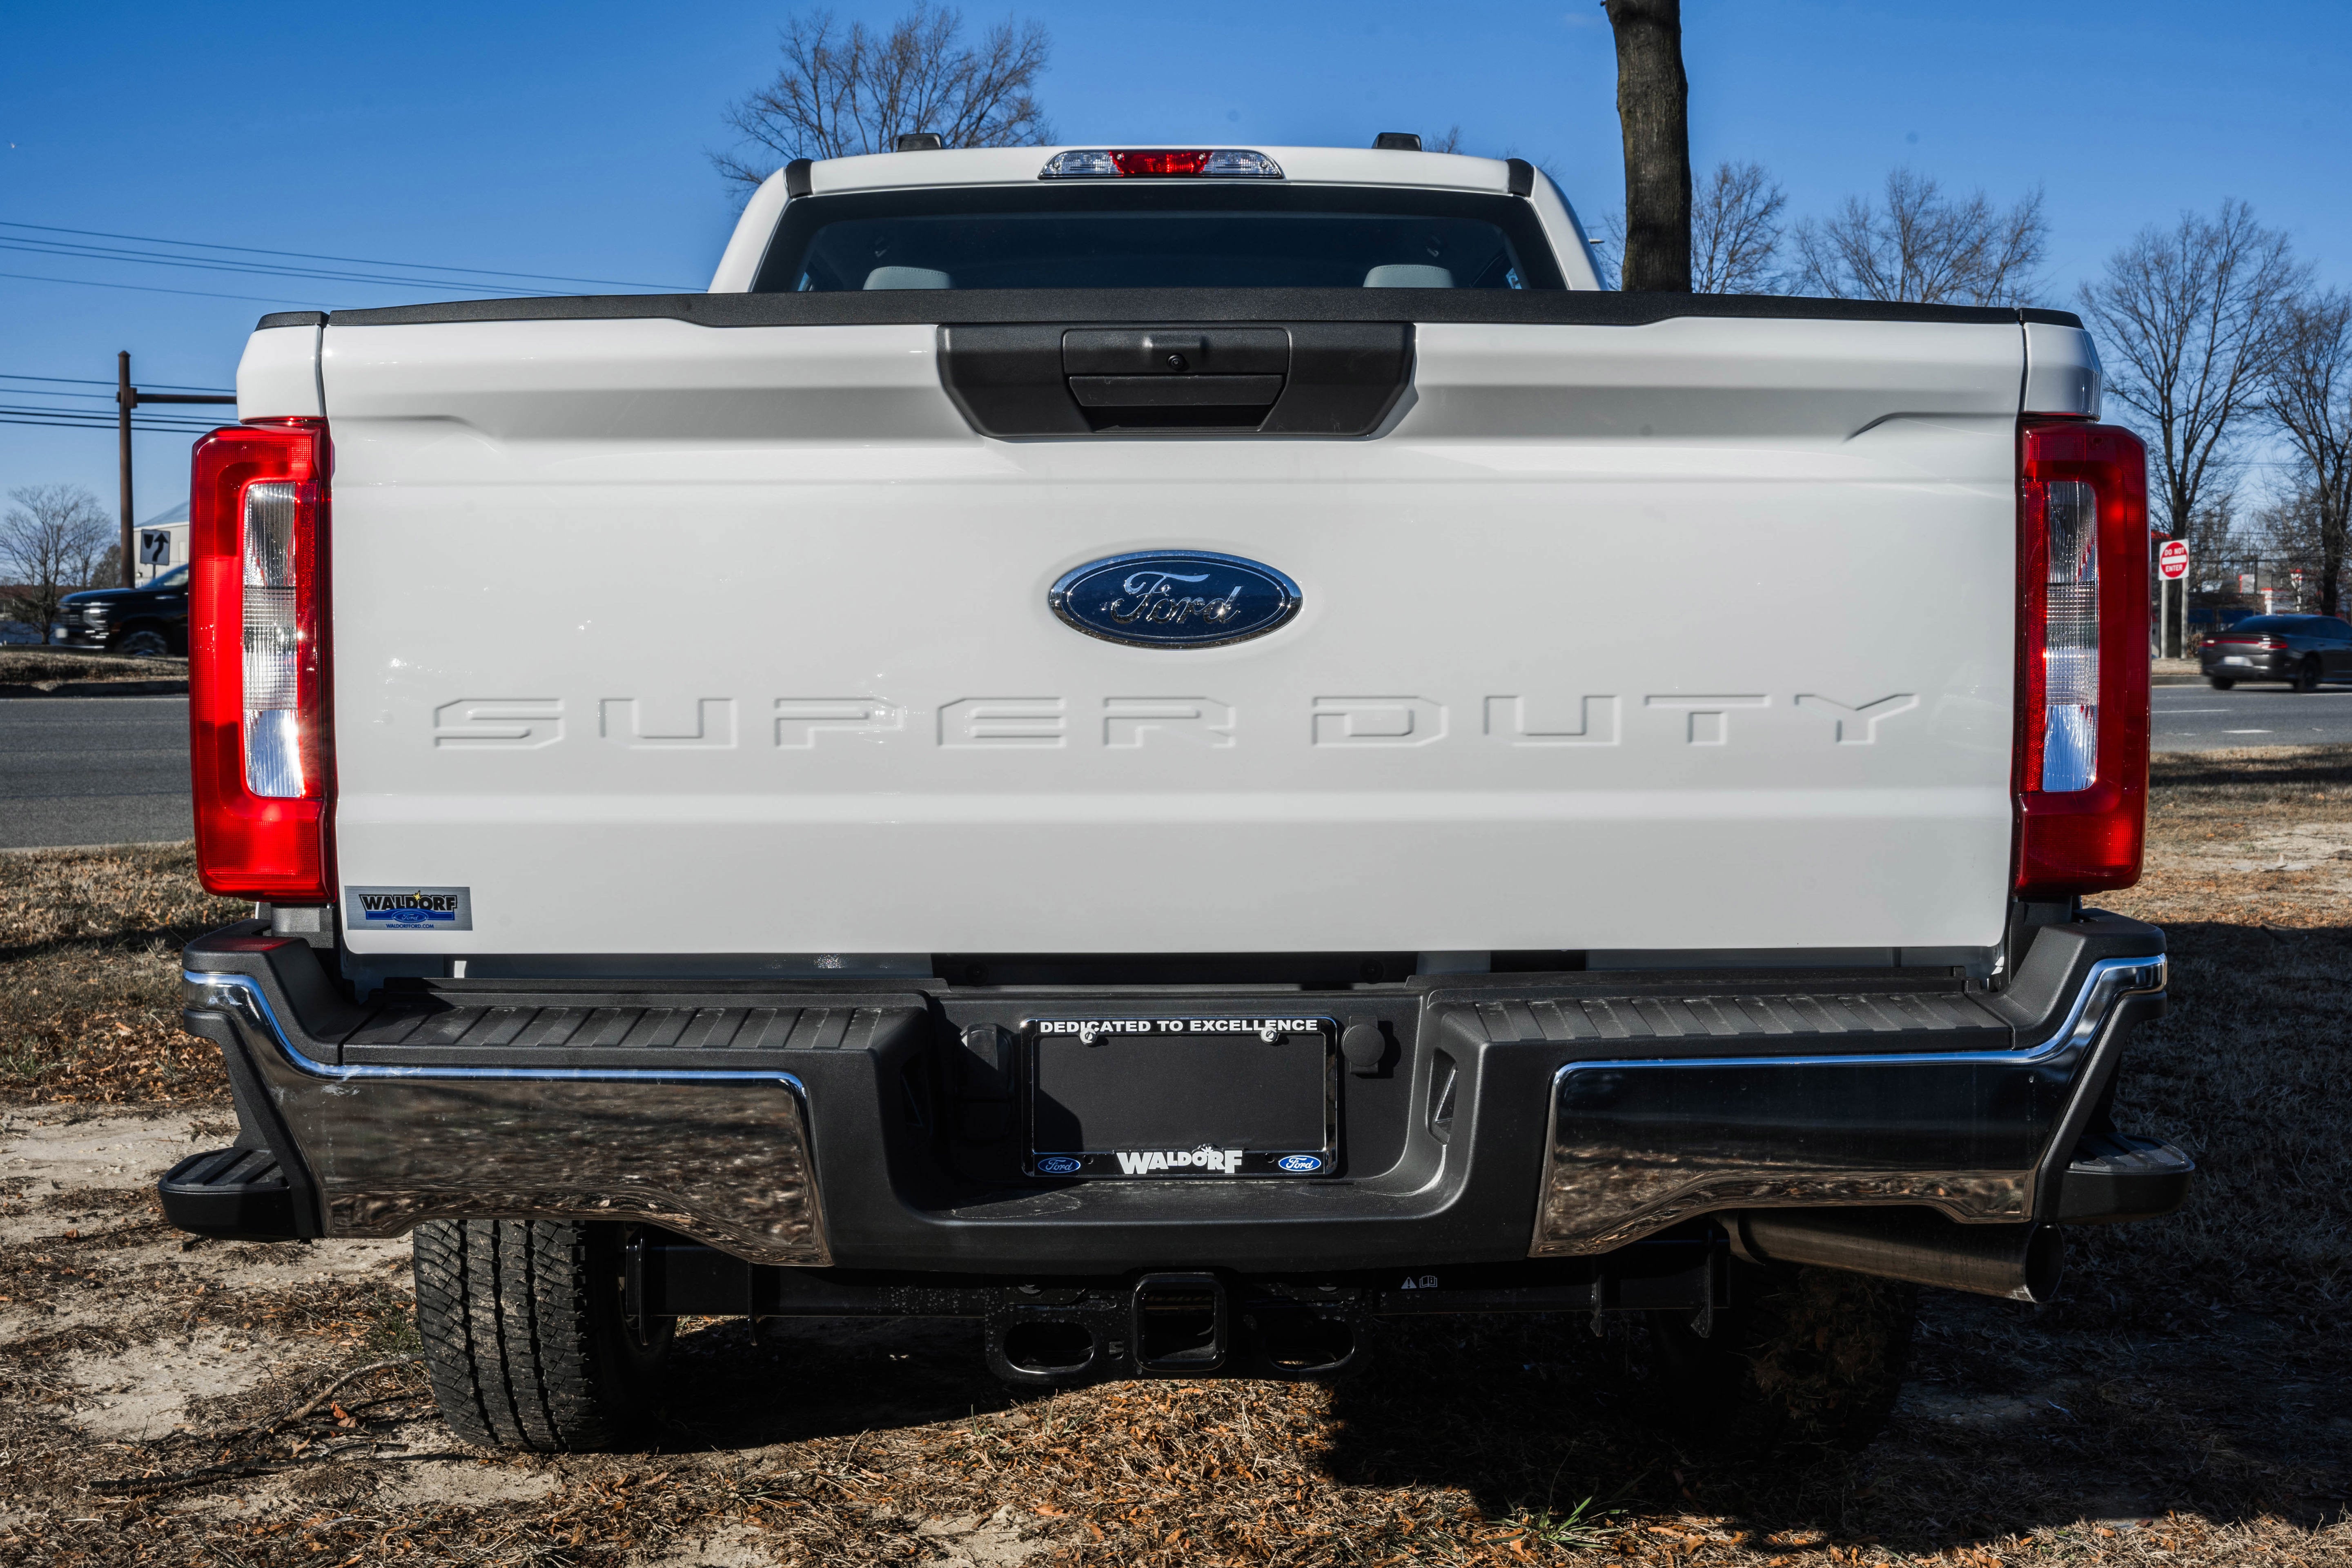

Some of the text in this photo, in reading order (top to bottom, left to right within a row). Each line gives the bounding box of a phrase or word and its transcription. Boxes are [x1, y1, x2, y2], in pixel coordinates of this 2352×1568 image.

[1111, 571, 1243, 624] Ford
[434, 694, 1919, 750] SUPER DUTY
[360, 895, 457, 911] WALDORF
[1040, 1020, 1317, 1032] DEDICATED TO EXCELLENCE
[1045, 1159, 1073, 1170] Ford
[1116, 1150, 1243, 1174] WALDORF
[1286, 1157, 1313, 1169] Ford
